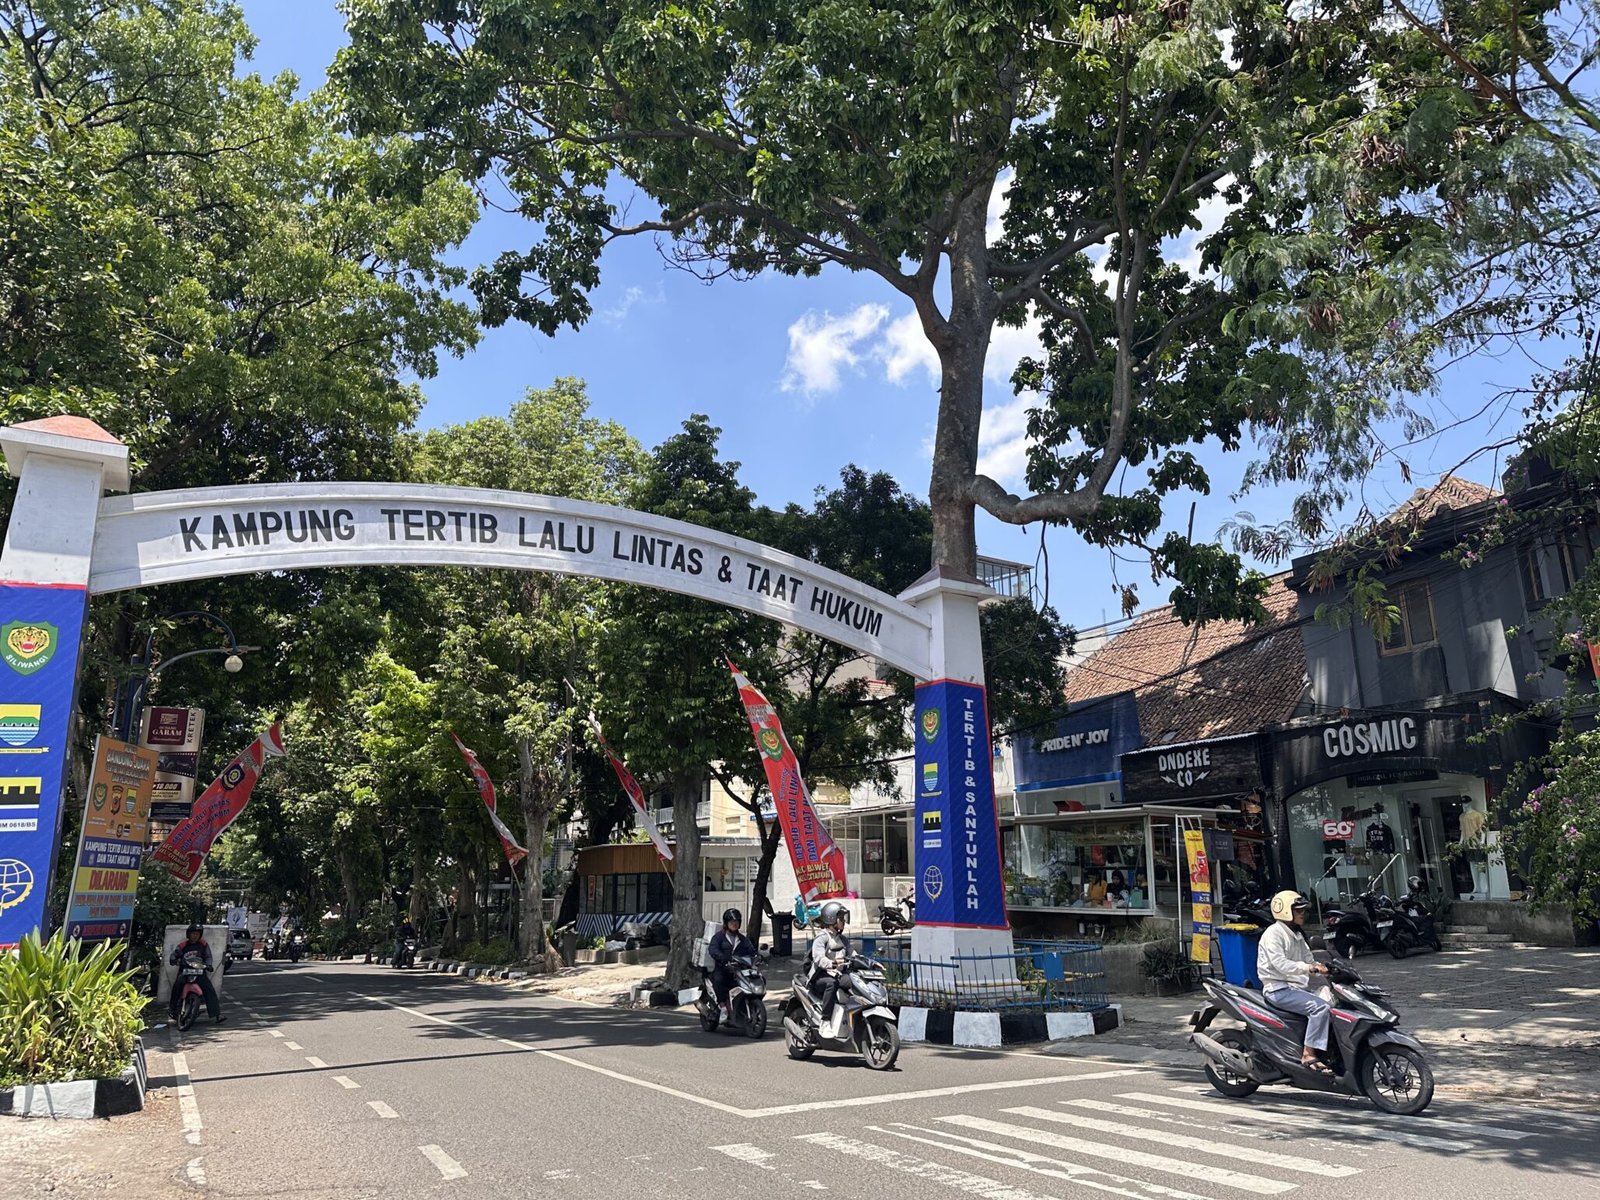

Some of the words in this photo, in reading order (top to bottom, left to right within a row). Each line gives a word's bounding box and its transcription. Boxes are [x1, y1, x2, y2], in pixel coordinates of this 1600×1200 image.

[179, 509, 356, 552] KAMPUNG
[380, 508, 498, 544] TERTIB
[518, 517, 595, 554] LALU
[613, 530, 704, 575] LINTAS
[717, 555, 732, 583] &
[746, 562, 804, 604] TAAT
[810, 586, 883, 637] HUKUM
[6, 654, 48, 668] SILIWANGI
[187, 711, 196, 743] KRETEK
[963, 698, 975, 771] TERTIB
[1085, 729, 1109, 745] JOY
[1323, 717, 1416, 757] COSMIC
[964, 776, 976, 787] &
[1176, 769, 1194, 788] CO
[803, 811, 814, 836] TAAT
[84, 841, 107, 852] KAMPUNG
[806, 840, 818, 861] DAN
[964, 792, 979, 909] SANTUNLAH
[96, 853, 107, 863] DAN
[107, 854, 118, 864] TAAT
[89, 870, 130, 890] DILARANG
